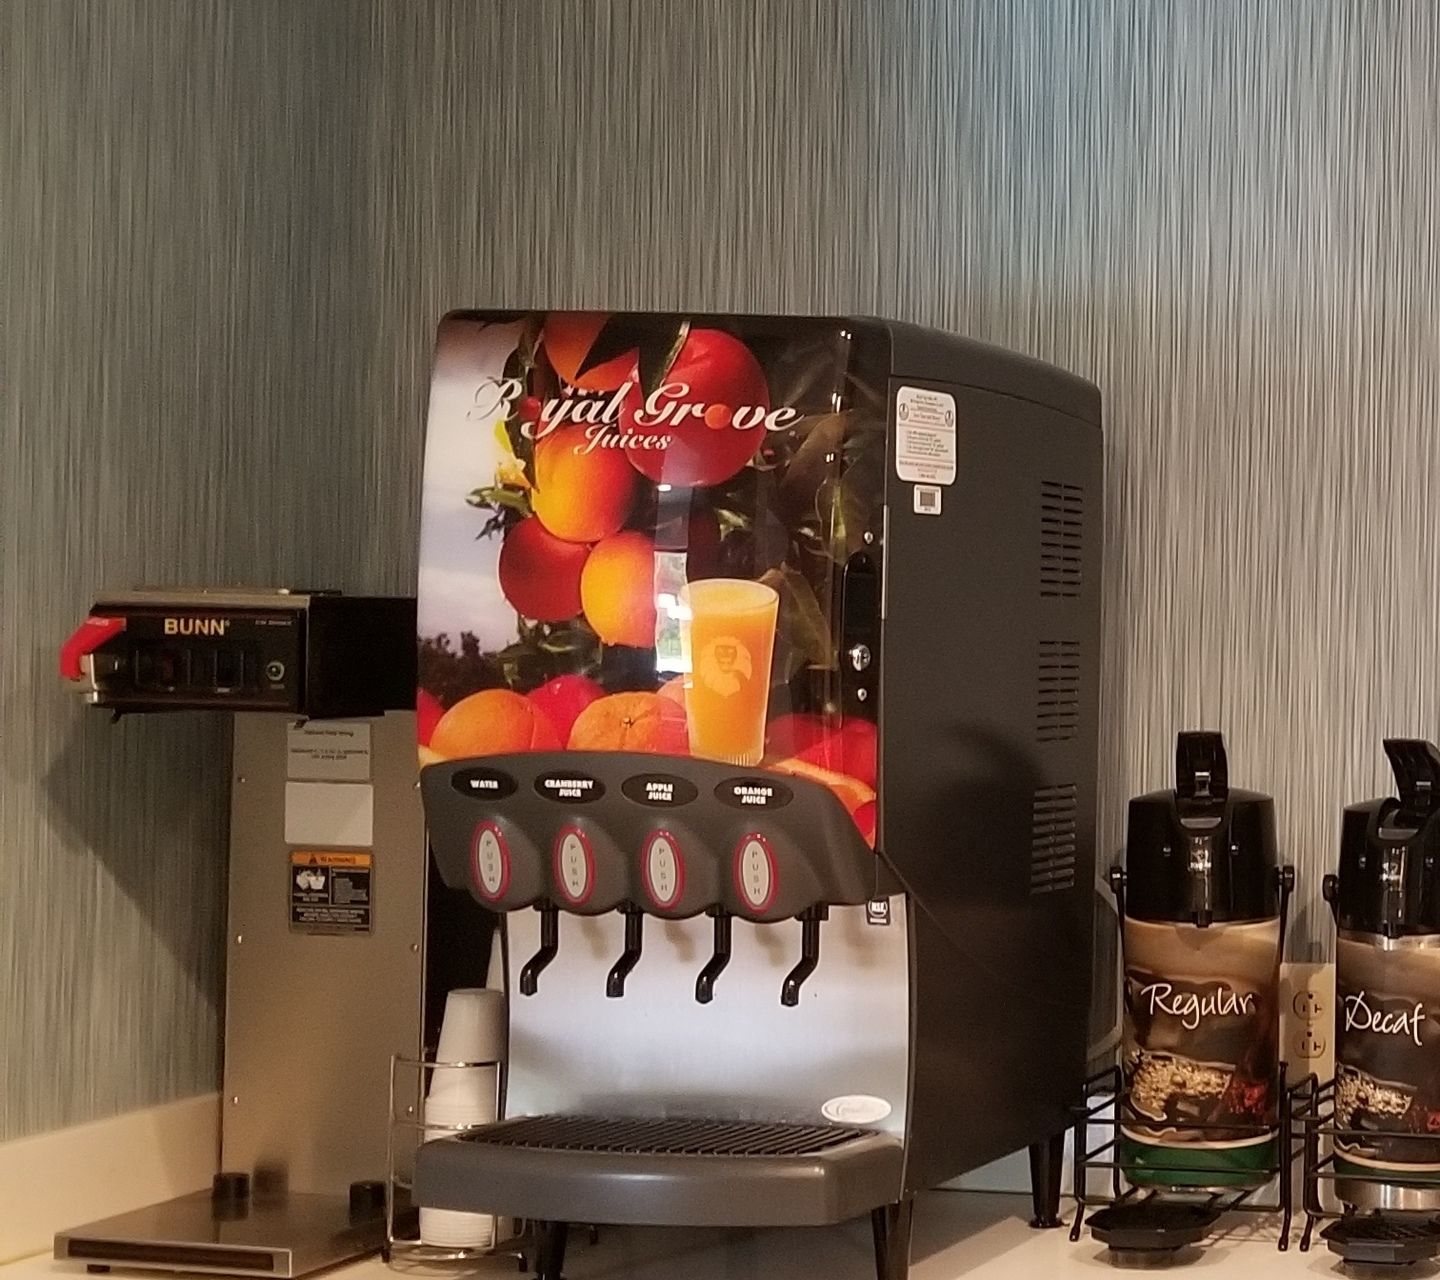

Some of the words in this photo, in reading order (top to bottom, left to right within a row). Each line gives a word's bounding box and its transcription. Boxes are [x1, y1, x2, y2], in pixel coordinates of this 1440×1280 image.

[633, 382, 807, 432] Grove
[573, 423, 672, 455] Juices
[164, 618, 225, 636] BUNN
[470, 779, 499, 789] WATER
[544, 779, 594, 790] CRANBERRY
[646, 783, 673, 792] APPLE
[558, 788, 582, 797] JUICE
[648, 792, 672, 801] JUICE
[733, 786, 773, 797] ORANGE
[741, 795, 766, 805] JUICE
[658, 847, 668, 892] PUSH
[751, 851, 761, 896] PUSH
[1140, 982, 1253, 1030] Regular
[1345, 990, 1425, 1047] Decaf
